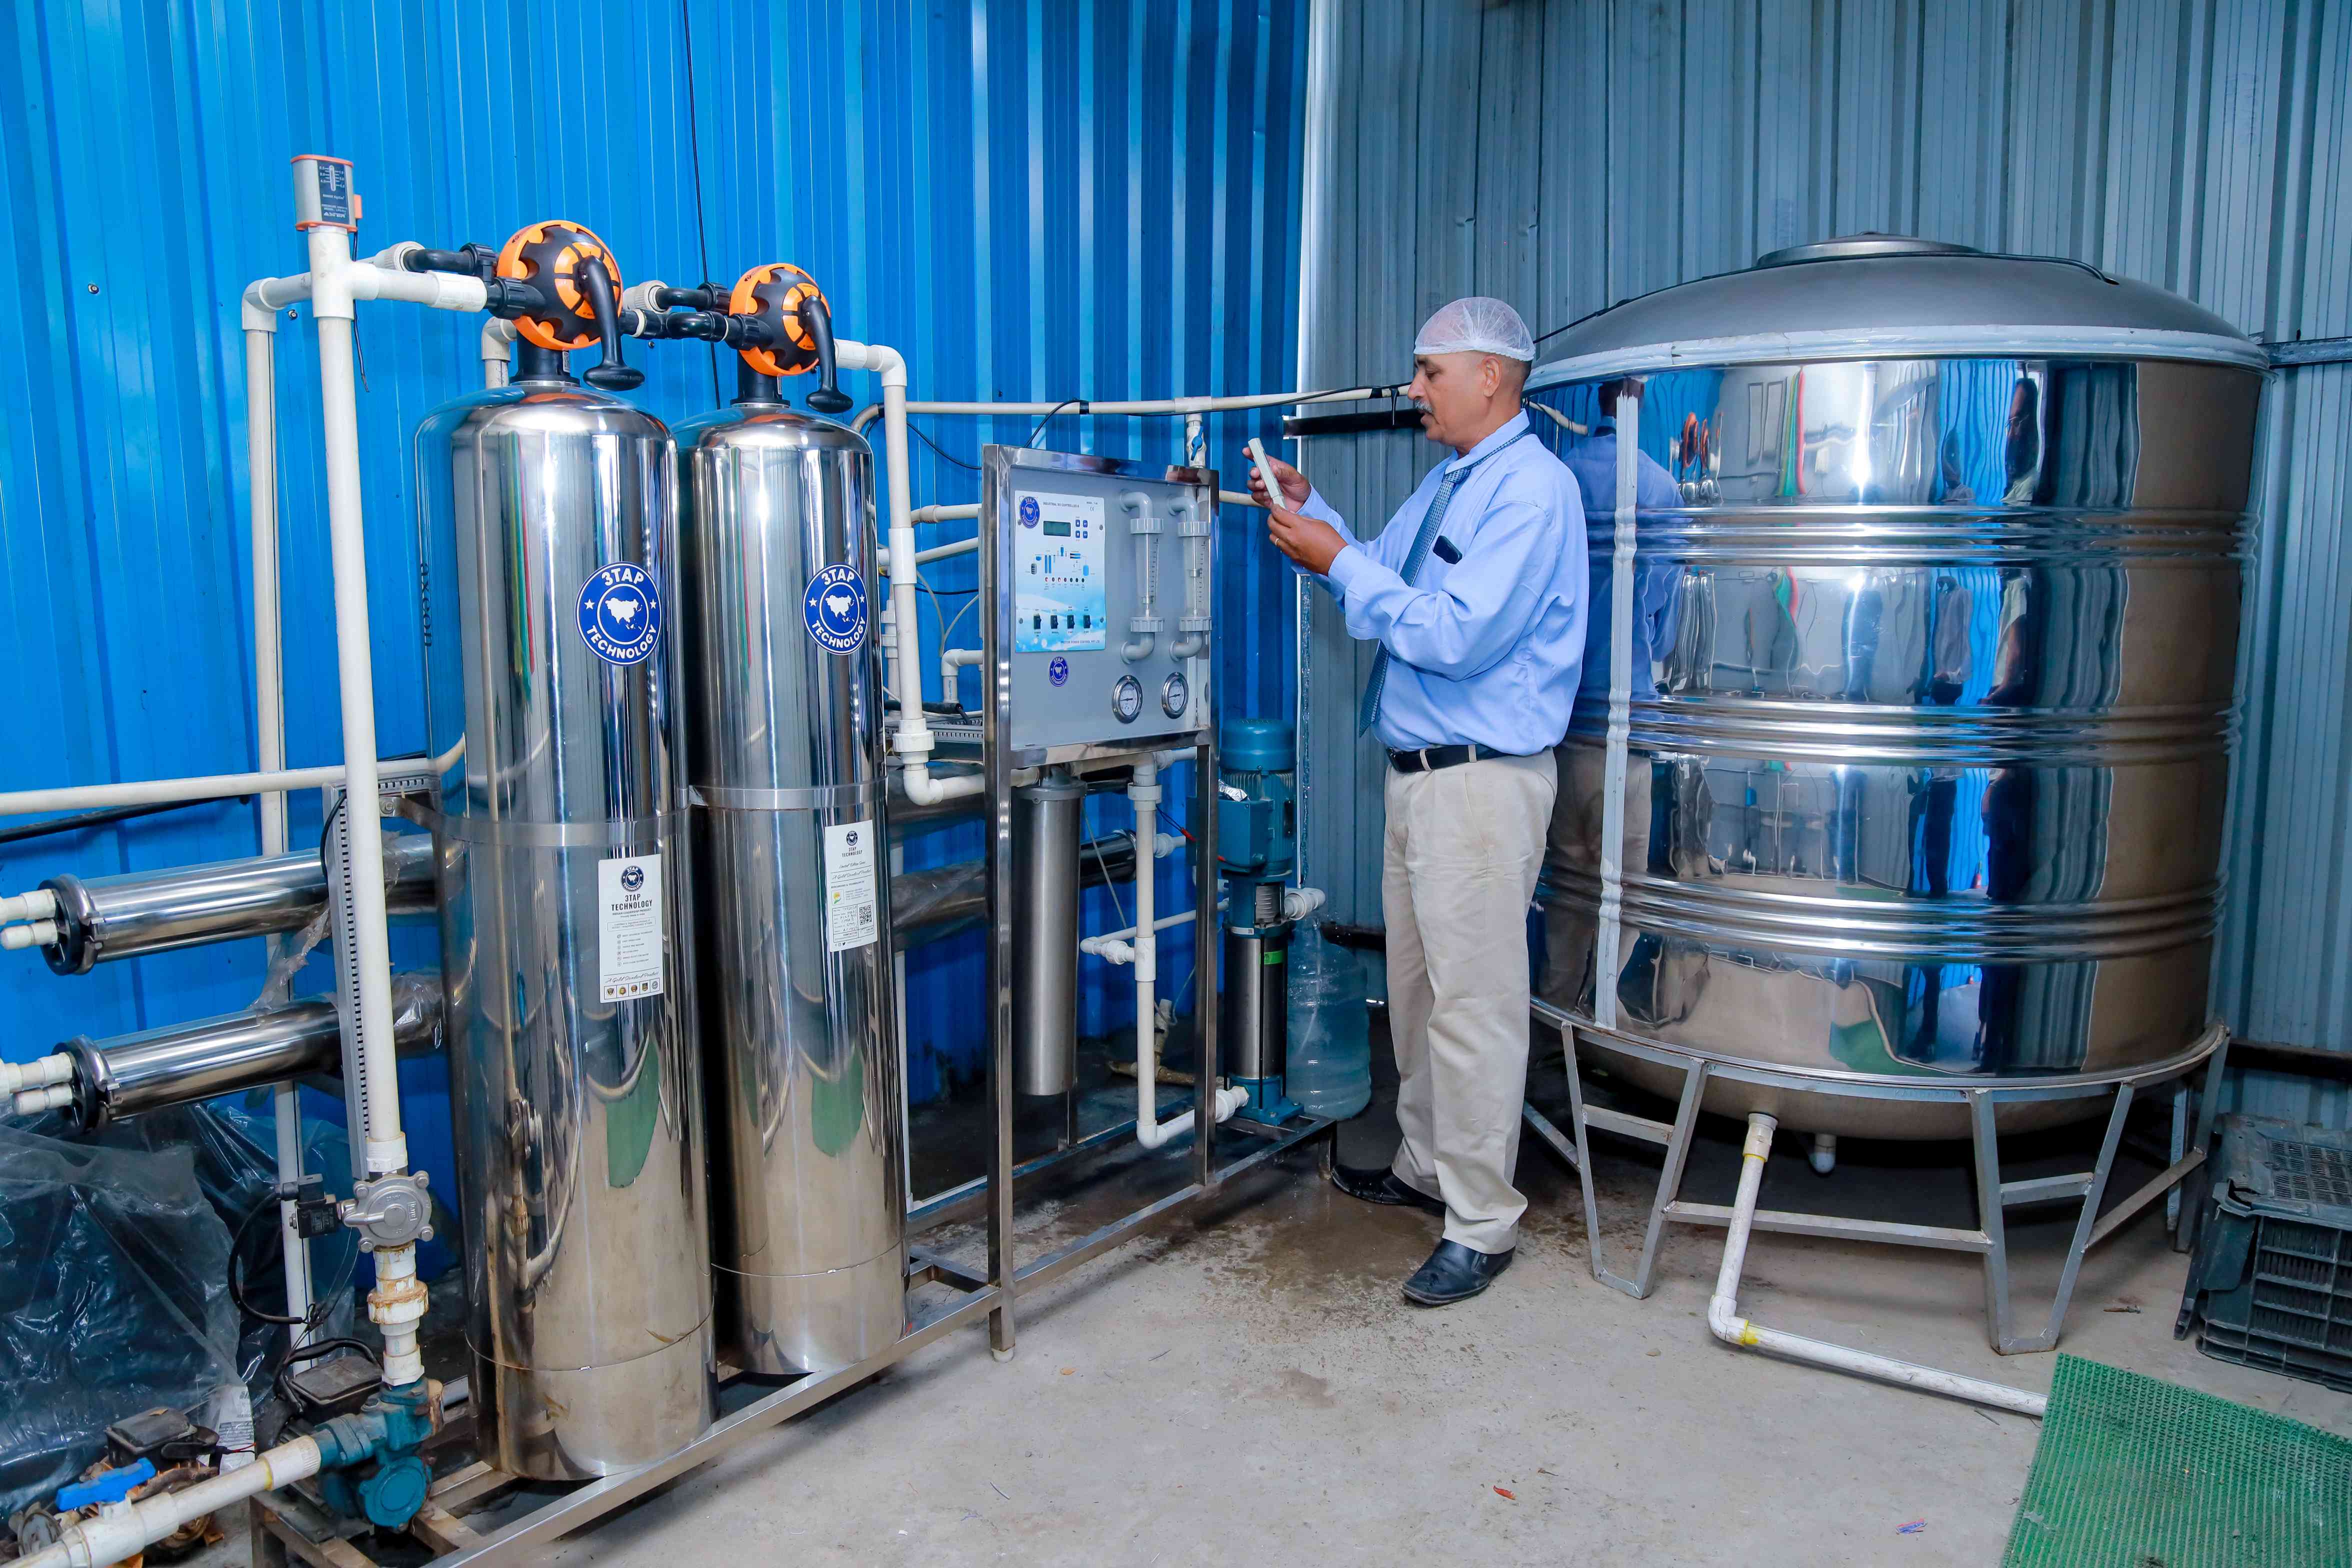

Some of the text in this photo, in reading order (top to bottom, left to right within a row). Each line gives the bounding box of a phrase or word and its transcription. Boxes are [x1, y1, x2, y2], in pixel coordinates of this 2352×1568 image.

[602, 568, 644, 586] 3TAP
[822, 568, 854, 585] 3TAP
[812, 616, 866, 648] TECHNOLOGY
[586, 624, 656, 659] TECHNOLOGY
[611, 899, 652, 911] TECHNOLOGY
[624, 894, 641, 902] 3TAP
